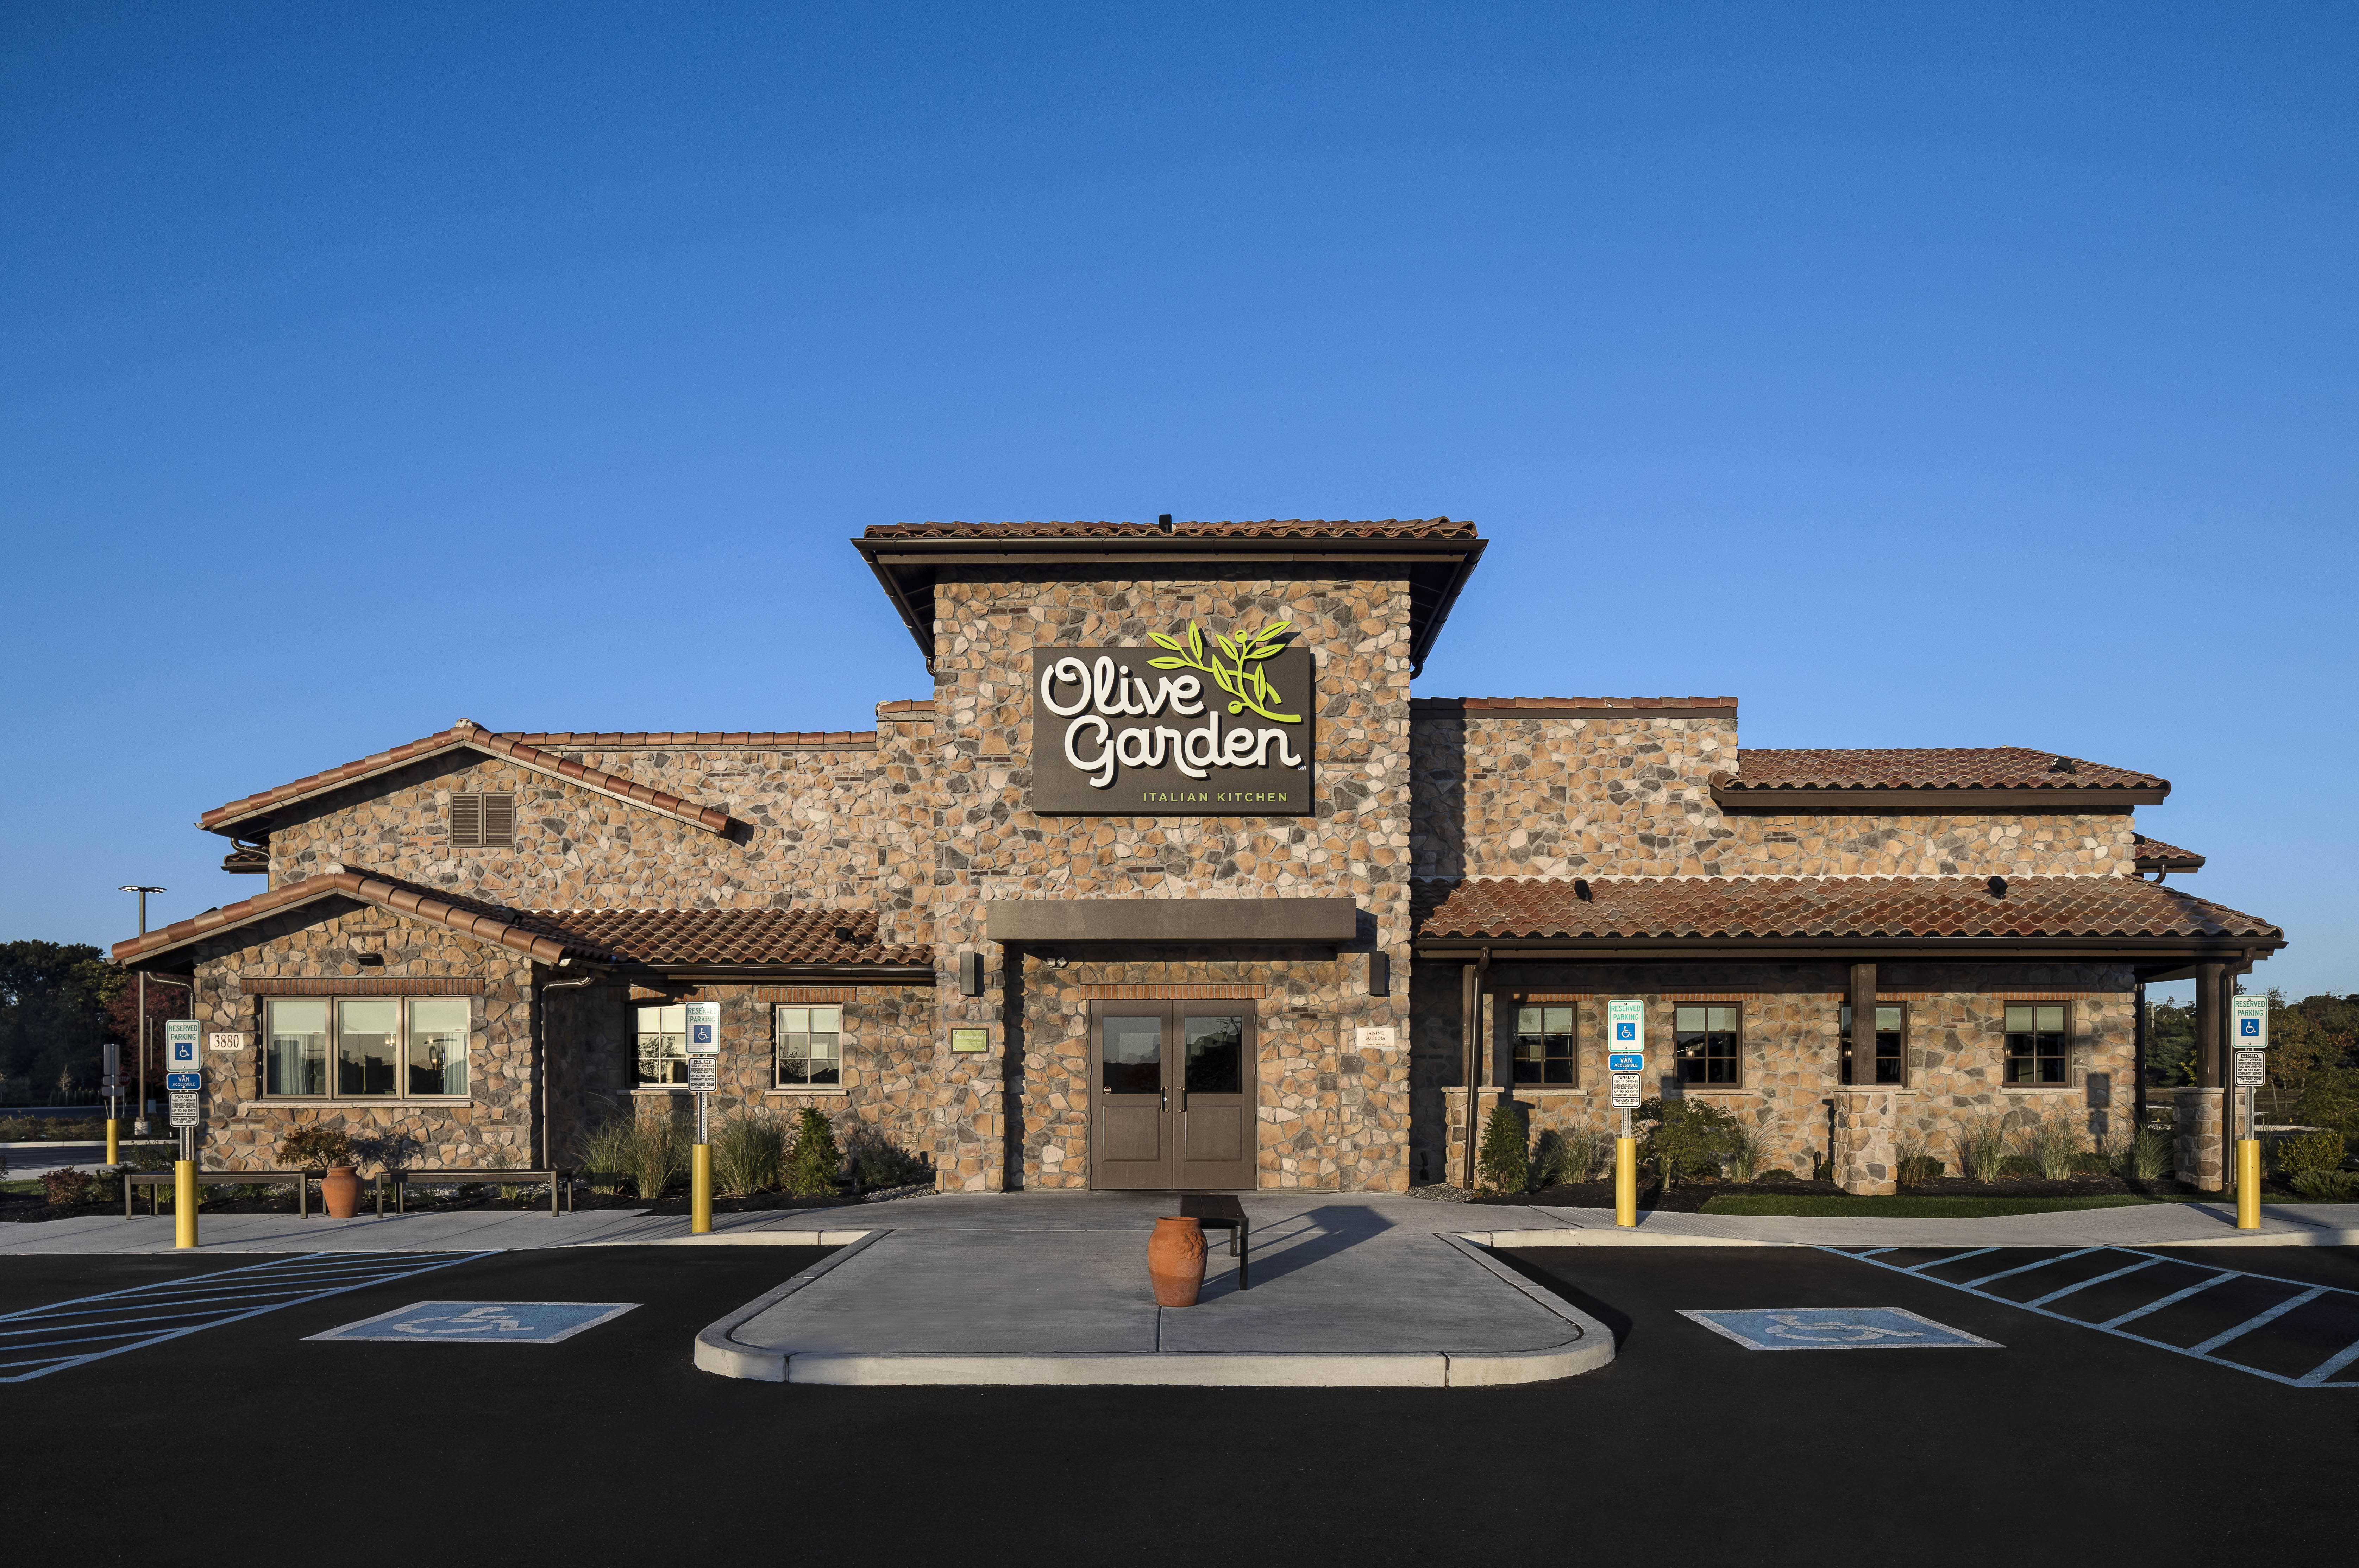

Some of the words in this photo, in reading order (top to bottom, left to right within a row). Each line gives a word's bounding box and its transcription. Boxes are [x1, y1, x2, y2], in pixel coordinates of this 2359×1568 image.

[1041, 656, 1204, 717] Olive
[1065, 711, 1302, 788] Garden
[1143, 792, 1208, 802] ITALIAN
[1217, 792, 1287, 802] KITCHEN
[214, 1034, 239, 1048] 3880
